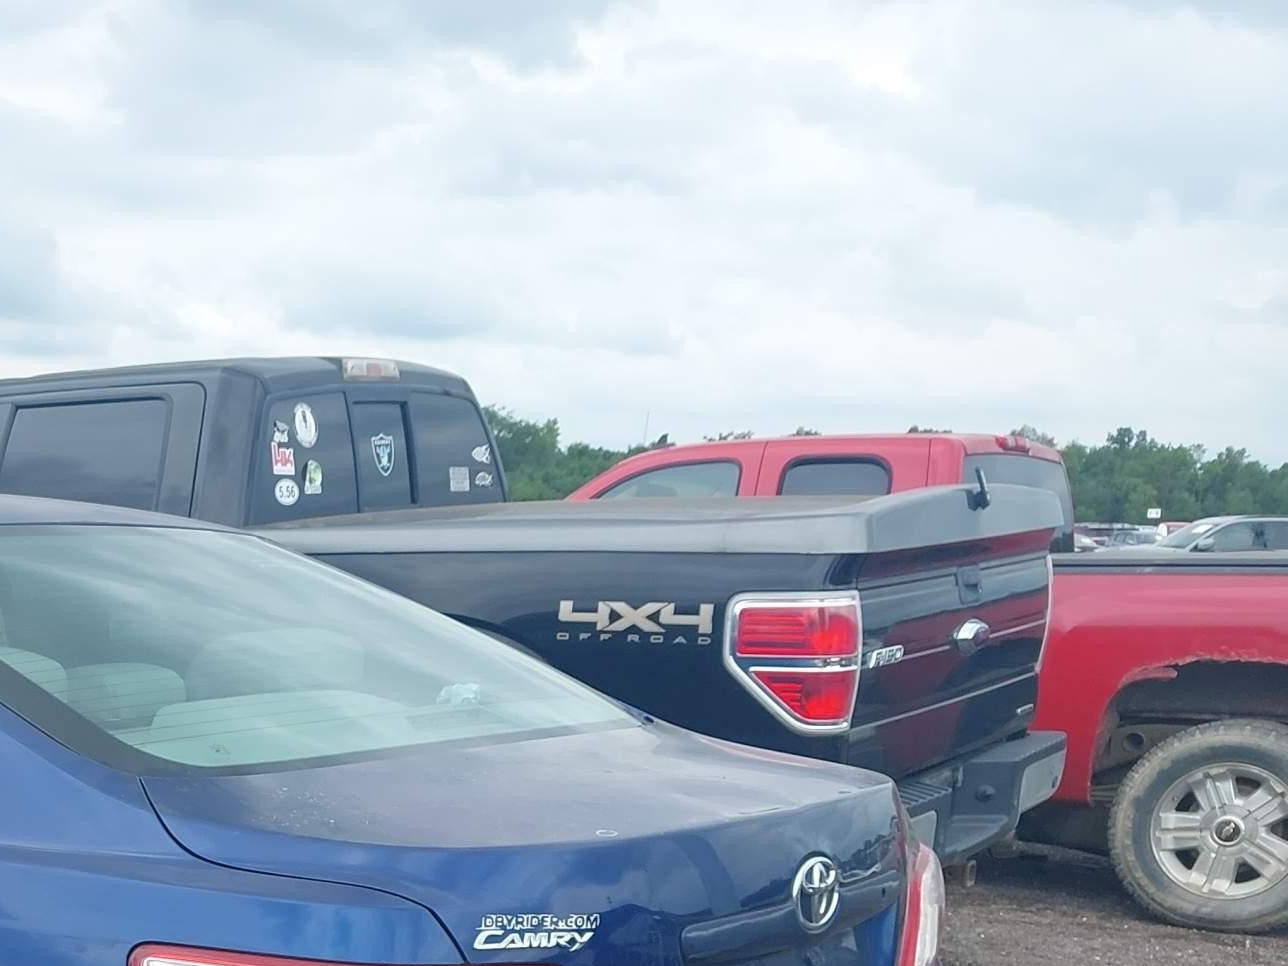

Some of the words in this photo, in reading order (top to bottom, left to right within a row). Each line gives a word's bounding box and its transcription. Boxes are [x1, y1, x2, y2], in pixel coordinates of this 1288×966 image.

[279, 486, 296, 498] 5.56
[556, 632, 612, 642] OFF
[627, 634, 712, 645] ROAD
